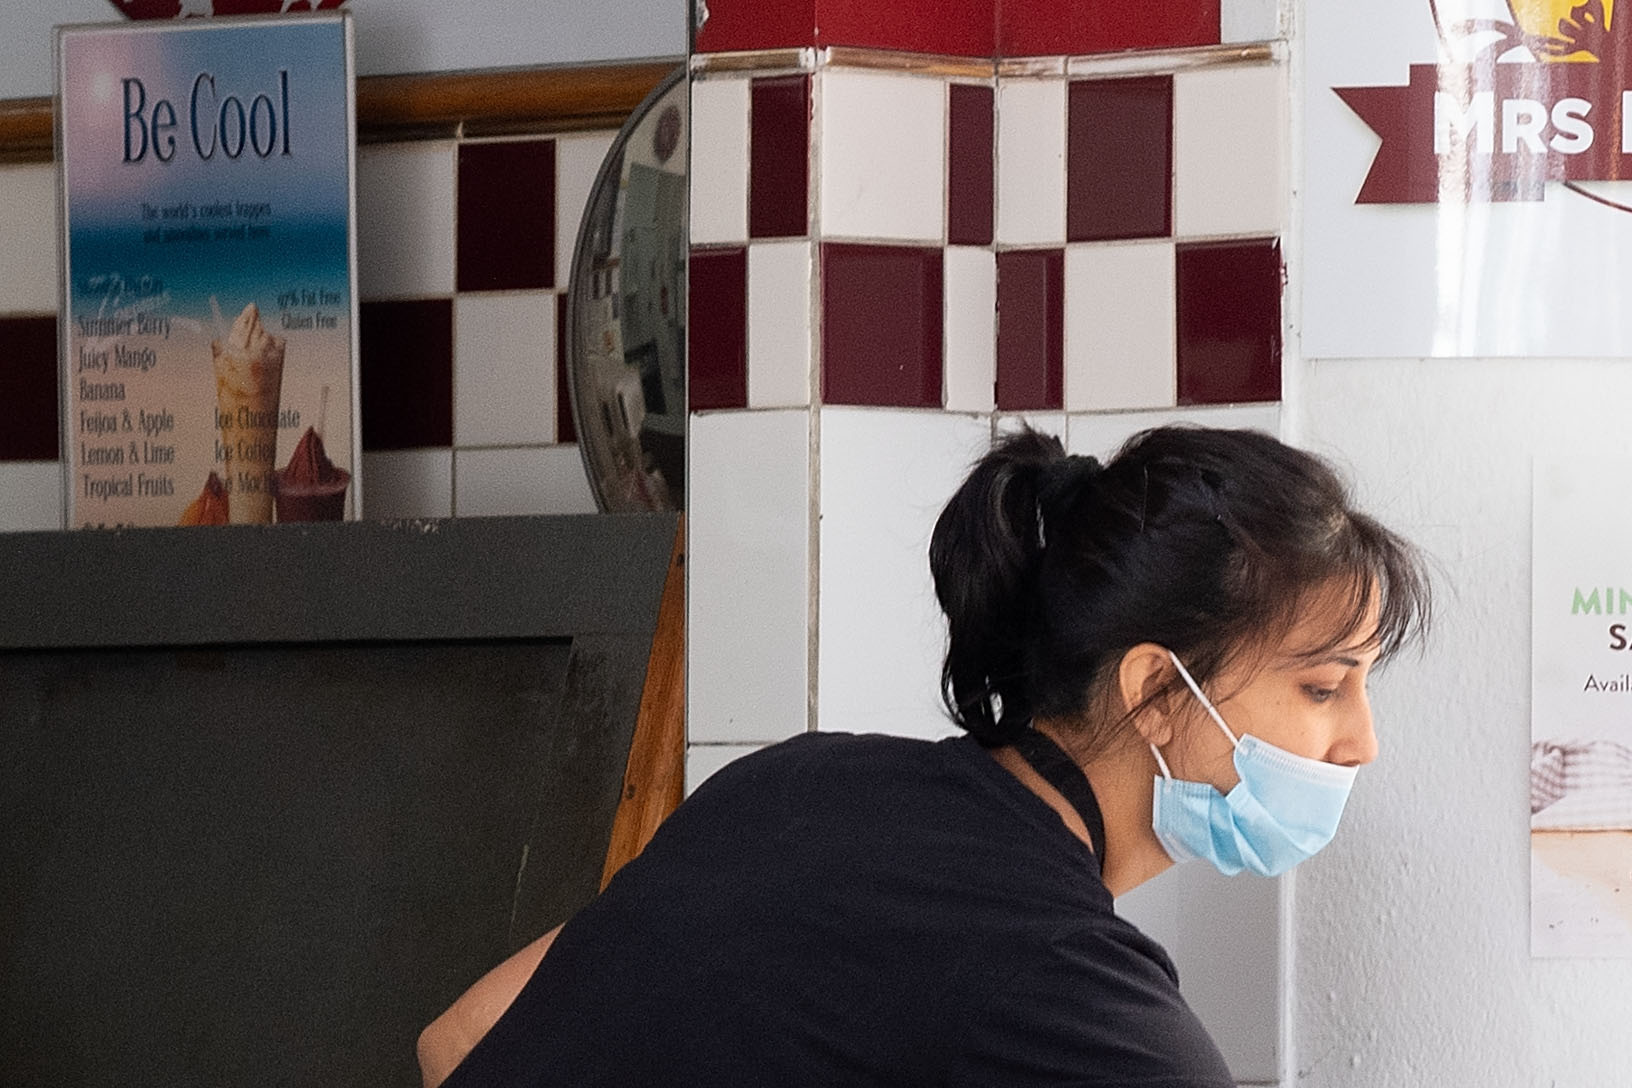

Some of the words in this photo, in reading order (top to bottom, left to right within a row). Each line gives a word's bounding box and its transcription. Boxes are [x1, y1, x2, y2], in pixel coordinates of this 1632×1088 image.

[121, 77, 177, 163] Be
[190, 70, 292, 161] Cool
[79, 346, 109, 374] Juicy
[115, 344, 156, 372] Mango
[80, 378, 126, 401] Banana
[122, 408, 133, 432] &
[139, 408, 174, 437] Apple
[82, 441, 124, 465] Lemon
[129, 441, 139, 464] &
[144, 441, 174, 465] Lime
[85, 473, 133, 501] Tropical
[138, 472, 174, 496] Fruits
